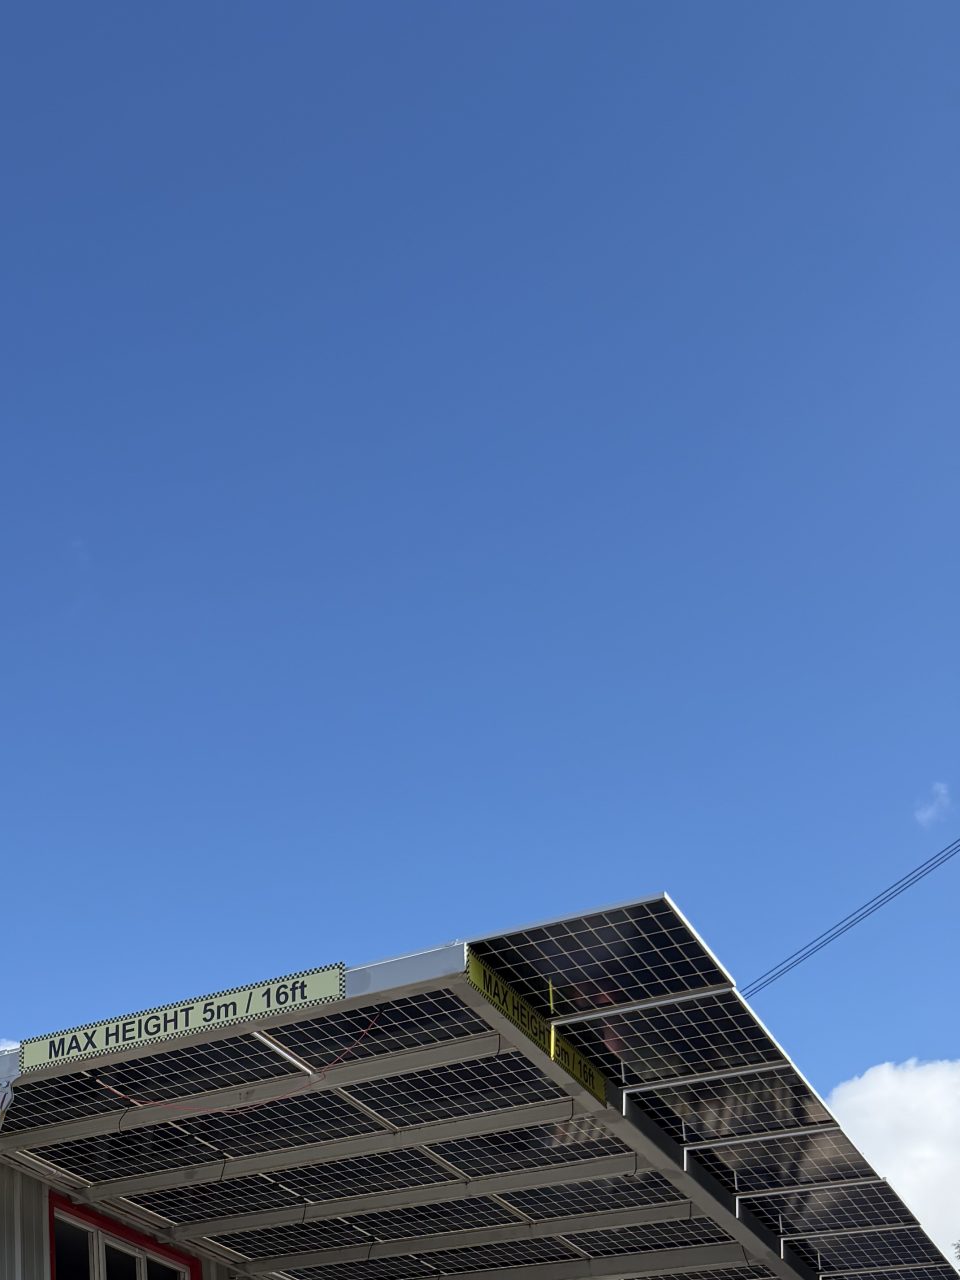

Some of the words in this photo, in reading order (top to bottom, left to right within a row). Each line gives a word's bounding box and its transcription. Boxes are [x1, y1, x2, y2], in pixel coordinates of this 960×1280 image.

[48, 1030, 97, 1059] MAX
[105, 1007, 193, 1042] HEIGHT
[201, 996, 238, 1024] 5m
[261, 980, 308, 1009] 16ft
[483, 969, 509, 1011] MAX
[555, 1037, 570, 1063] 5m
[578, 1060, 596, 1089] 16ft
